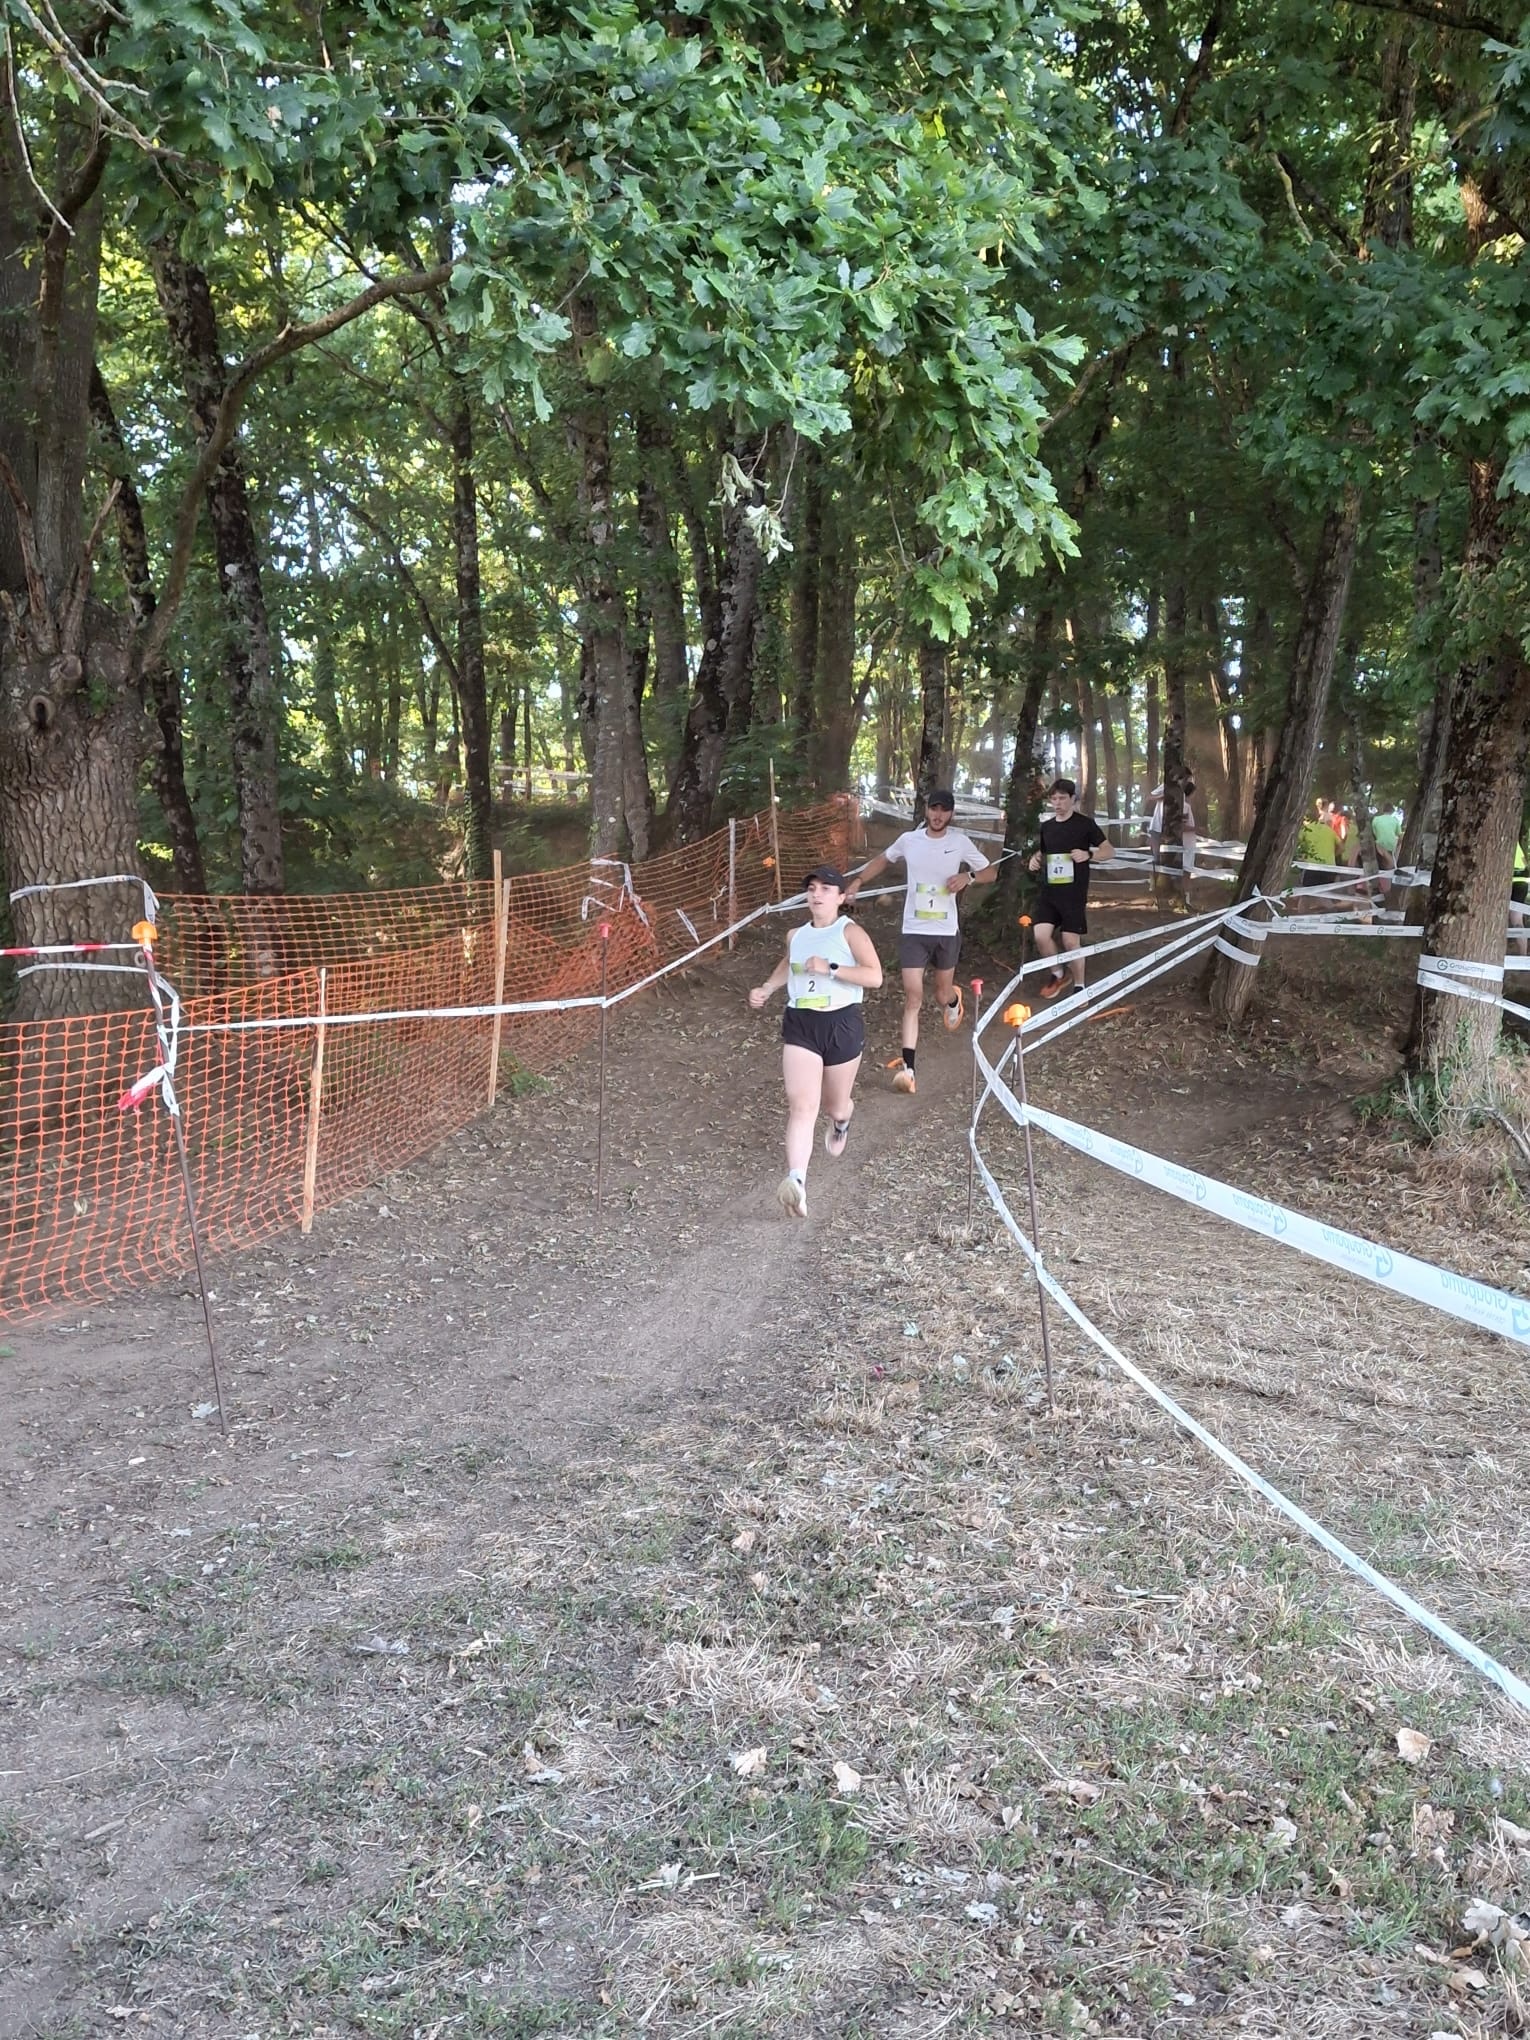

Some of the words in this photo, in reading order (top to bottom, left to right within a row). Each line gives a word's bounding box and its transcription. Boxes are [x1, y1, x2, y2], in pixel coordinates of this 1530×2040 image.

[1053, 866, 1064, 875] 47
[928, 899, 934, 908] 1
[808, 980, 816, 992] 2
